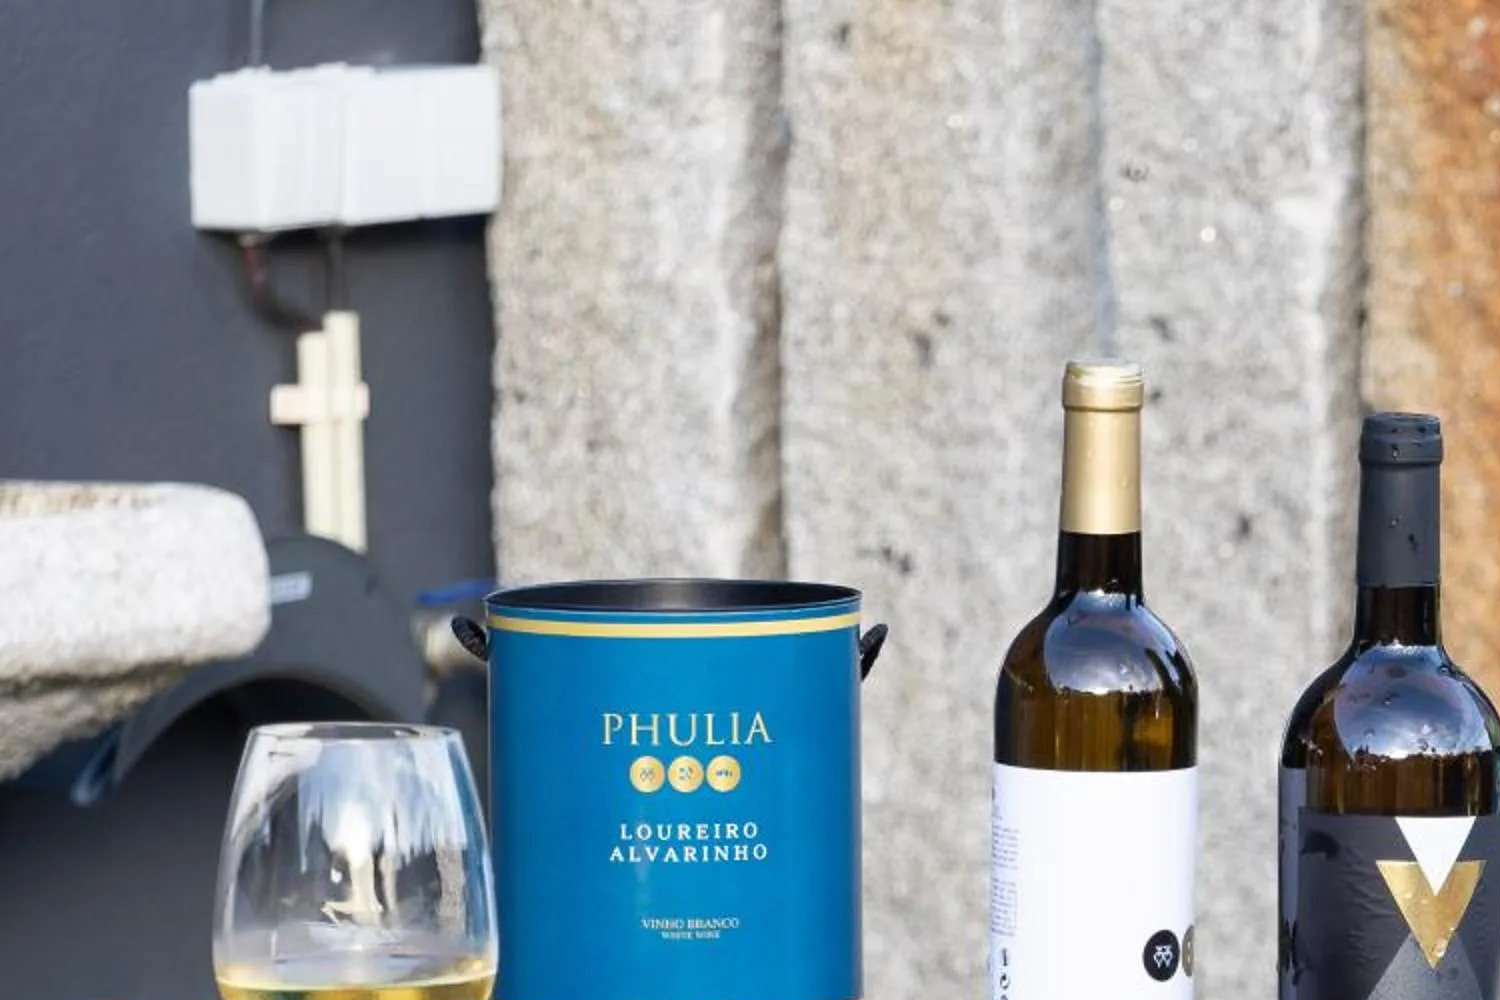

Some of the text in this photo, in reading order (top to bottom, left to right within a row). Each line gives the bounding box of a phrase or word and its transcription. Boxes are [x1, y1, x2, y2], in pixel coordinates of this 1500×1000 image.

[601, 711, 773, 747] PHULIA
[620, 821, 759, 842] LOUREIRO
[609, 843, 768, 863] ALVARINHO
[641, 917, 740, 929] VINHO BRANCO
